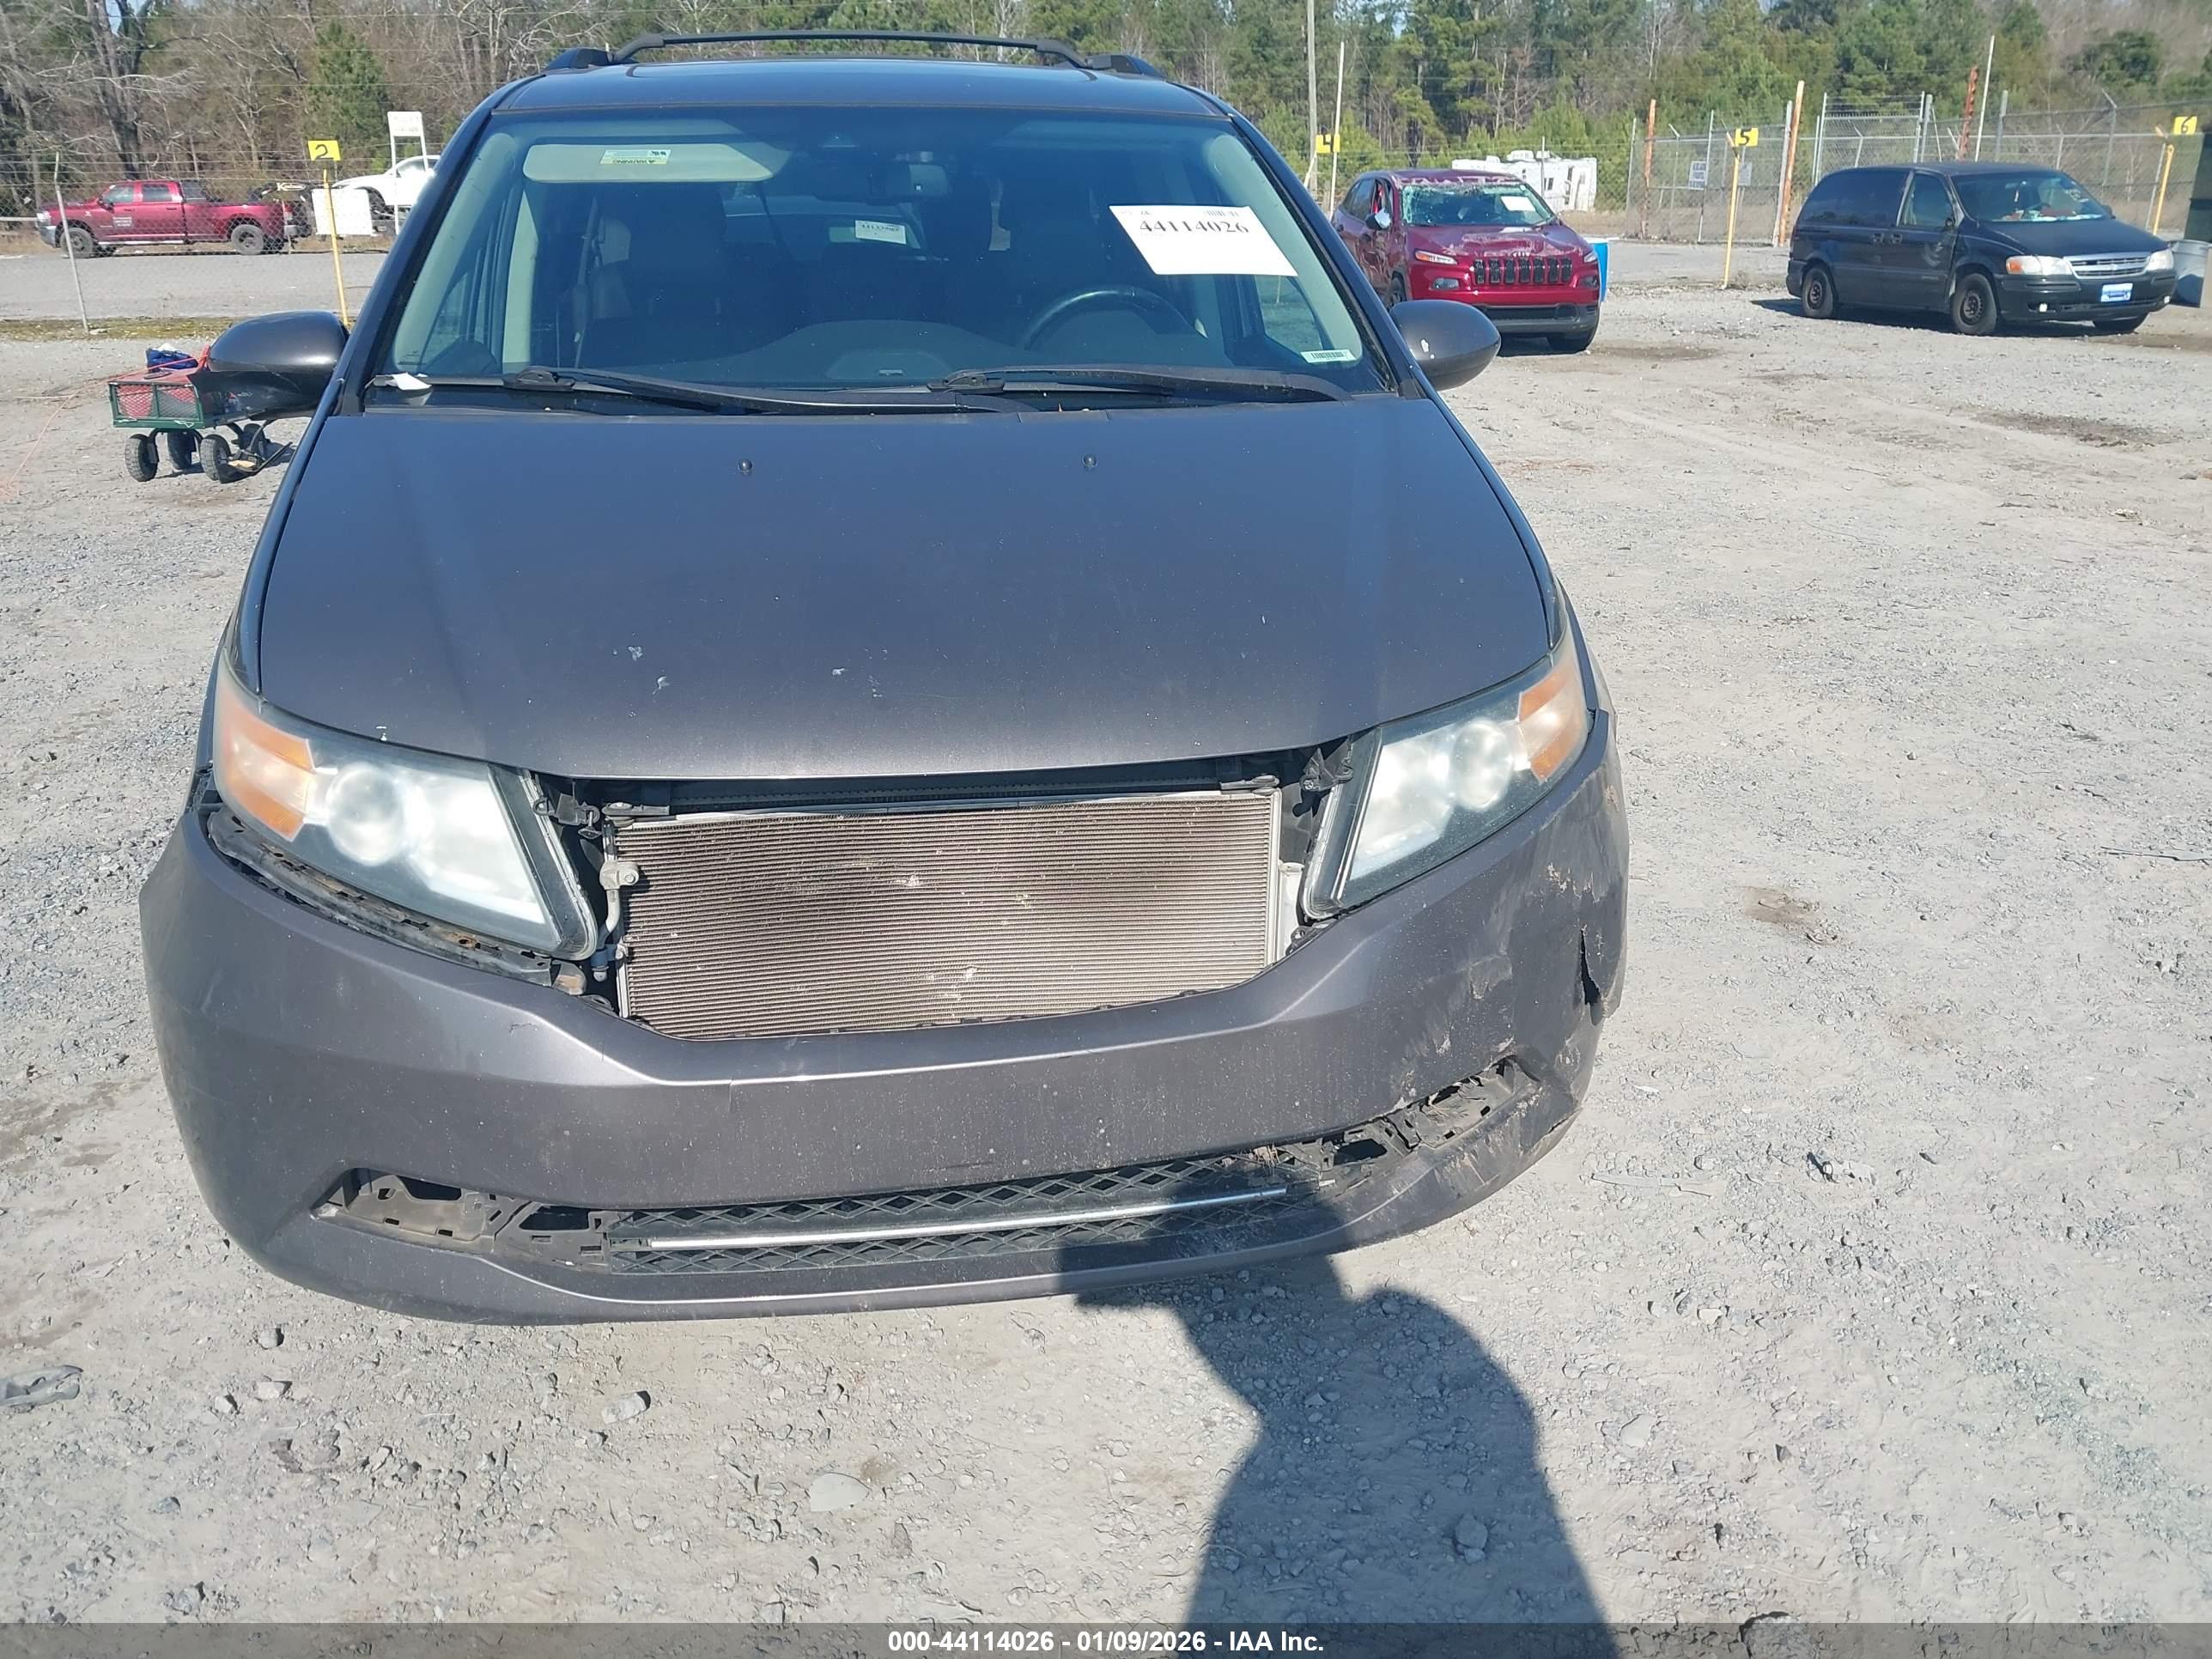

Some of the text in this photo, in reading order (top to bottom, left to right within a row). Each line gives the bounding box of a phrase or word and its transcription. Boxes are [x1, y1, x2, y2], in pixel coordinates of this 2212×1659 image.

[2181, 115, 2193, 134] 6
[1323, 134, 1334, 152] 4
[1739, 128, 1752, 145] 5
[314, 143, 334, 160] 2
[1139, 221, 1249, 233] 44114026
